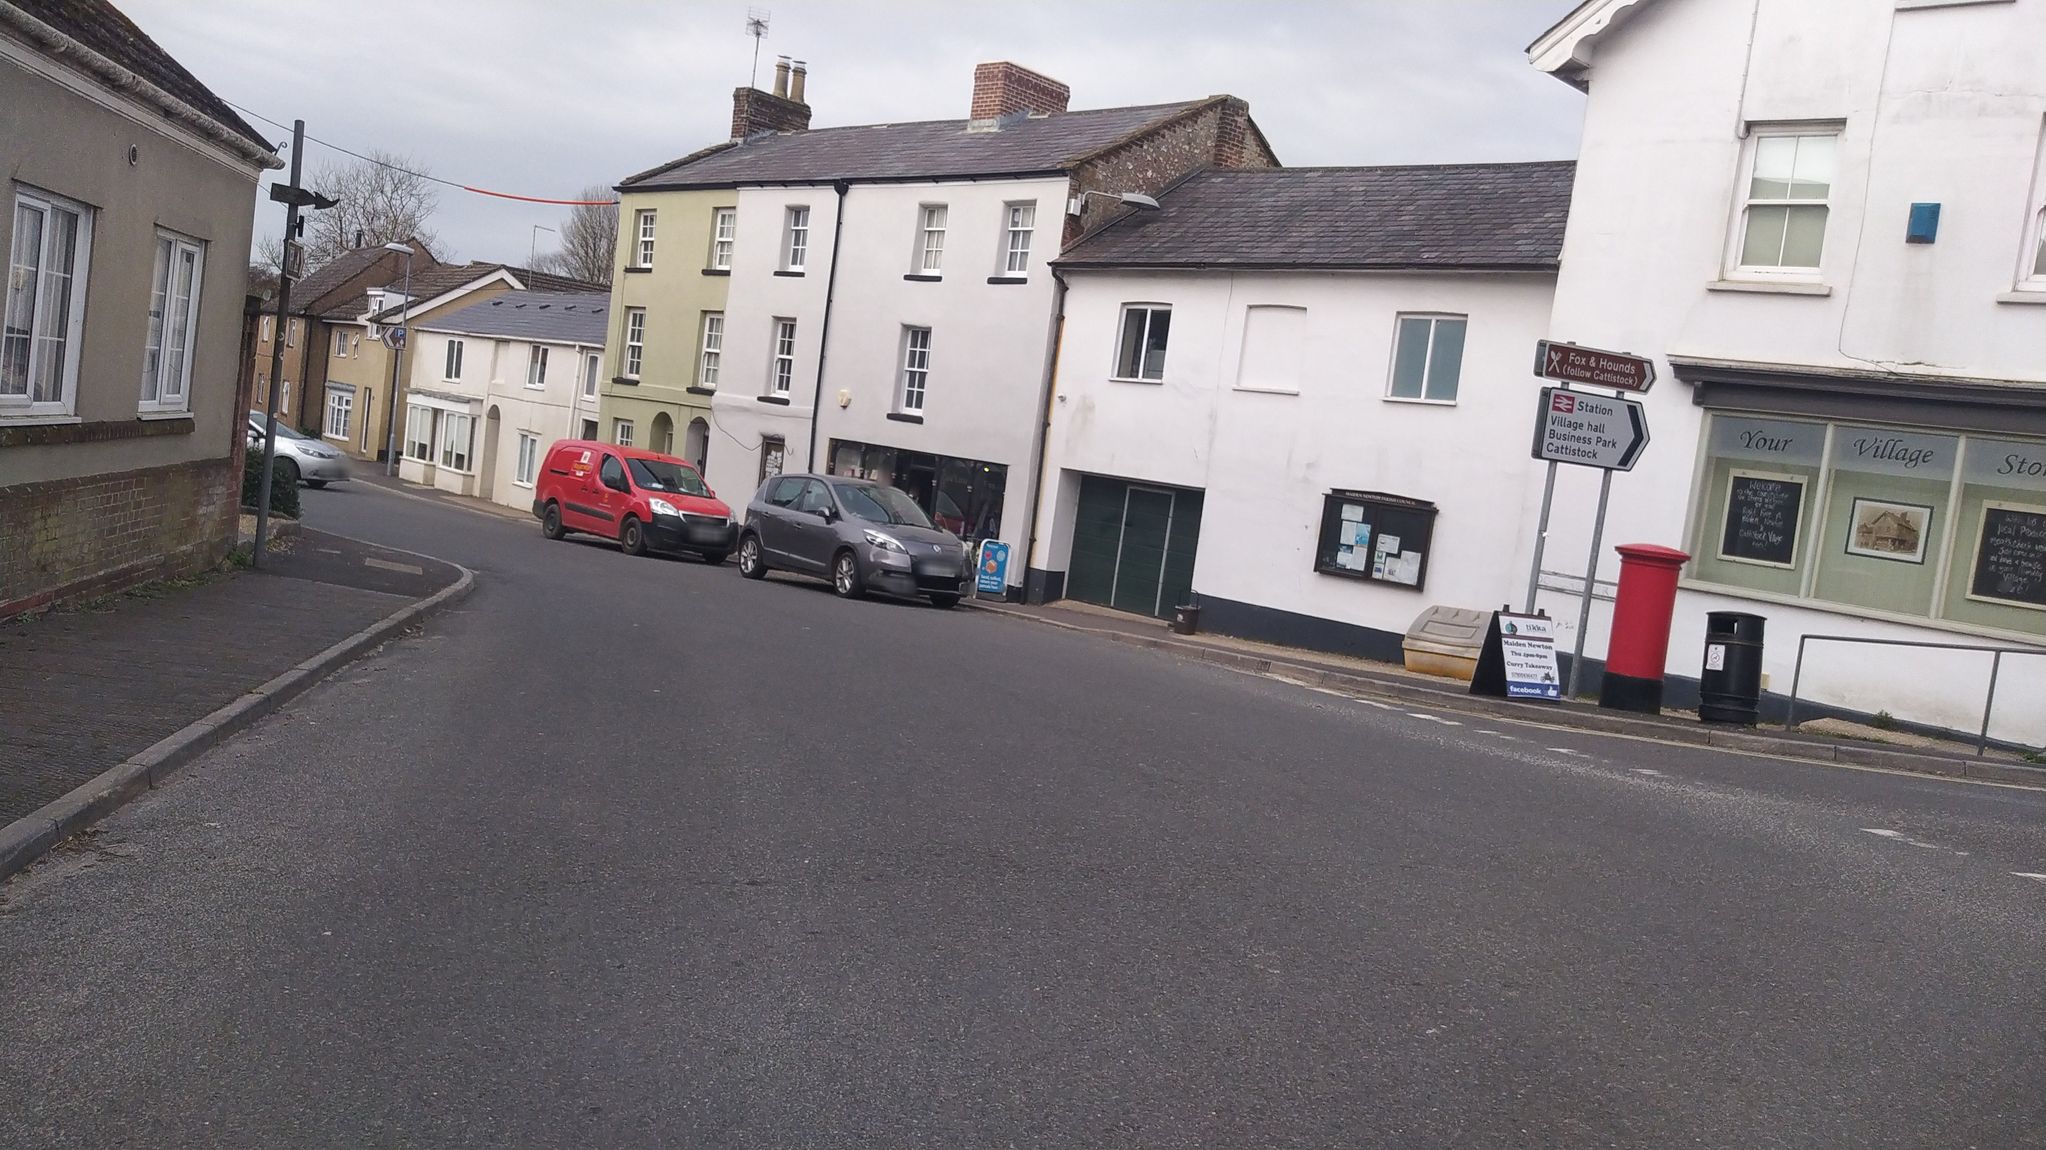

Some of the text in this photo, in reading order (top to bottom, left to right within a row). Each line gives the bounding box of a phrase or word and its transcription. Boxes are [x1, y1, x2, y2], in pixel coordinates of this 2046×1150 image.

[1568, 352, 1636, 374] Fox & Hounds
[1562, 364, 1638, 387] (follow Cattistock)
[1577, 401, 1613, 416] Station
[1551, 415, 1605, 434] Village hall
[1548, 429, 1617, 449] Business Park
[1546, 442, 1598, 459] Cattistock
[1740, 430, 1793, 452] Your
[1853, 437, 1934, 469] Village
[1504, 640, 1553, 651] Maiden Newton
[1524, 663, 1553, 671] Takeaway
[1510, 685, 1542, 694] facebook
